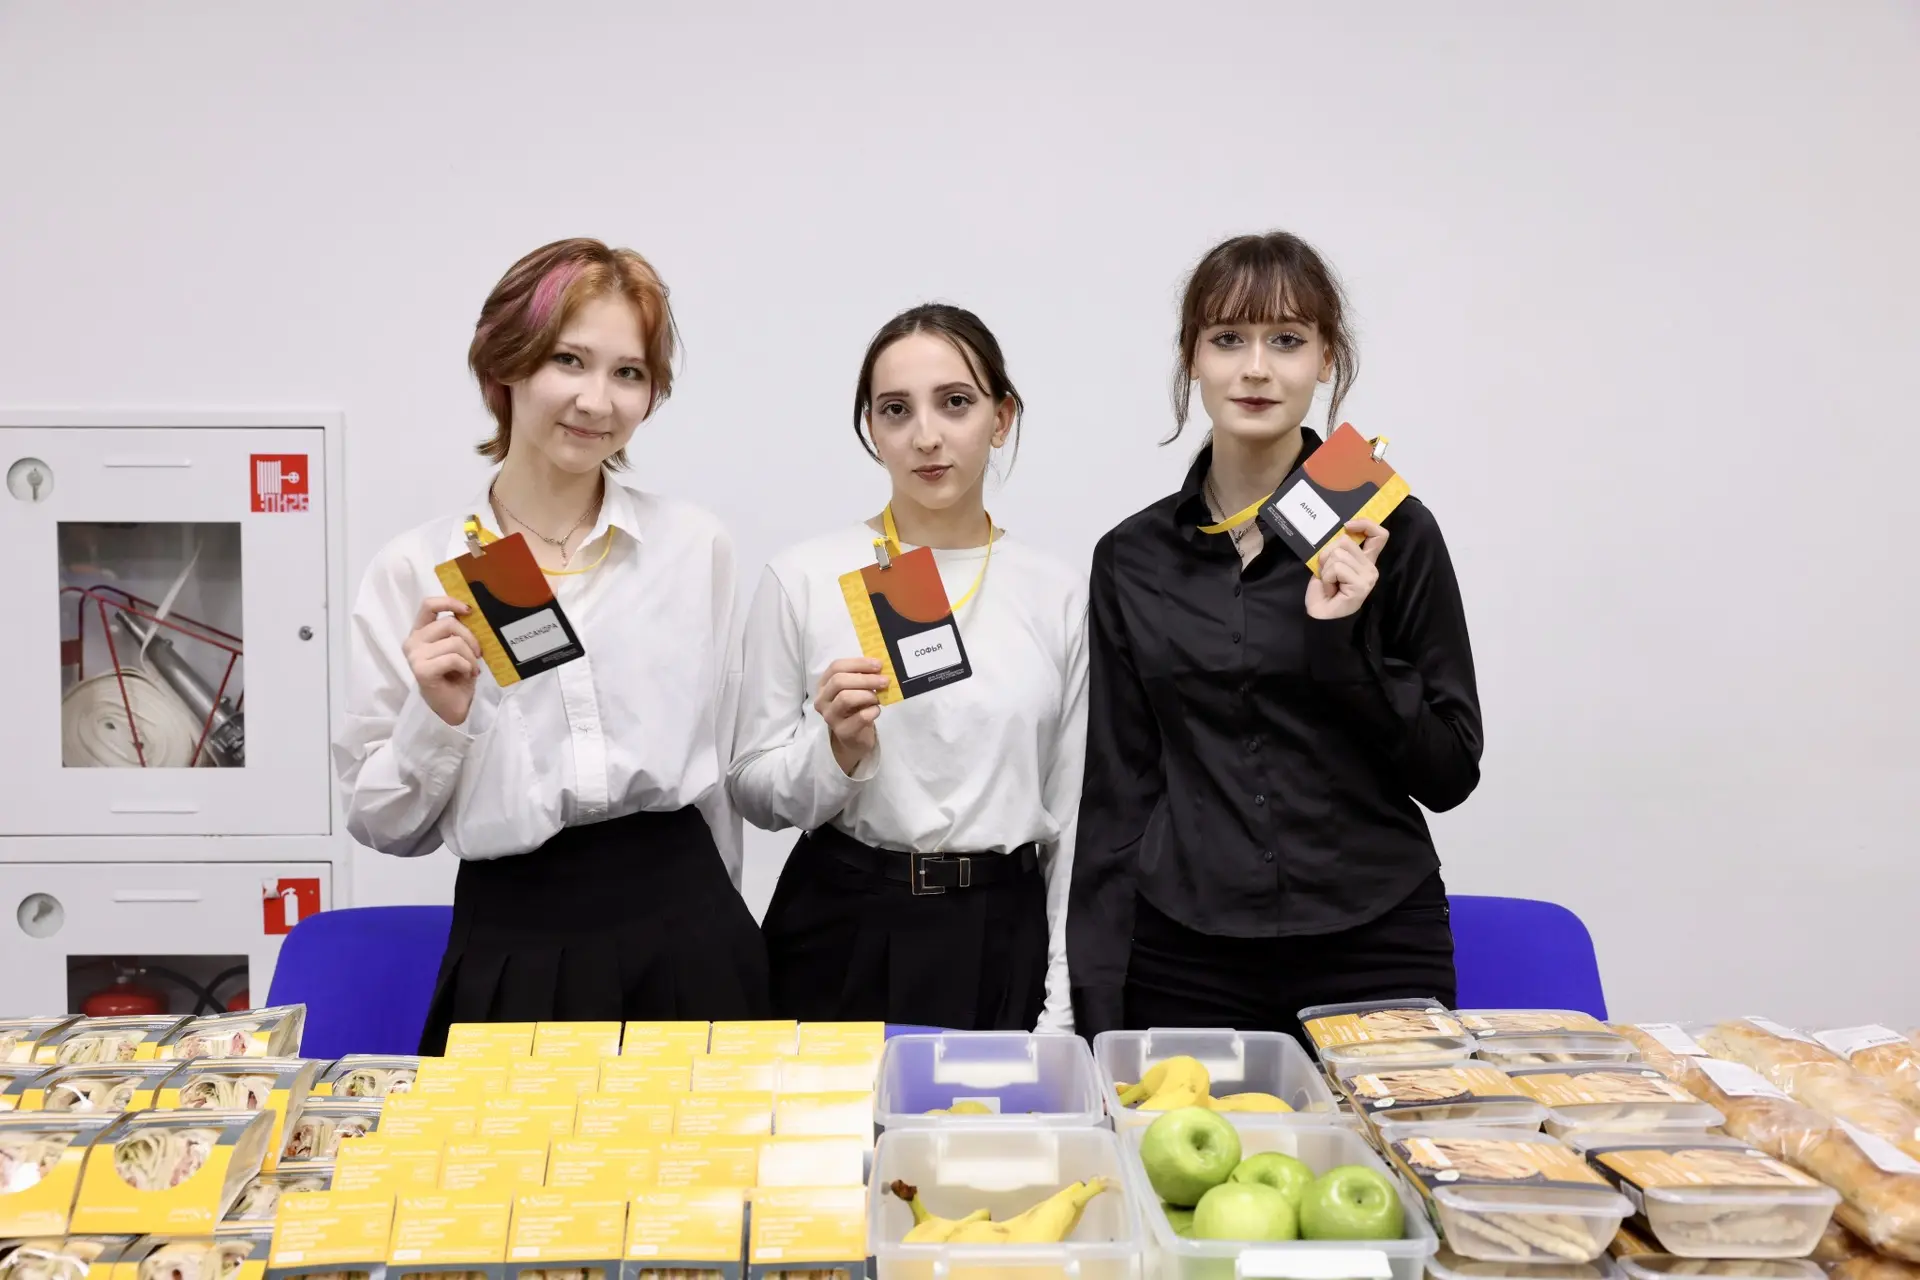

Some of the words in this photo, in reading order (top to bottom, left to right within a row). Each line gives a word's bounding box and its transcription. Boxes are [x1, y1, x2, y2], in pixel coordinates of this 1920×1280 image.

[1299, 502, 1317, 520] АННА
[510, 622, 558, 645] АЛЕКСАНДРА
[914, 643, 942, 656] СОФЬЯ
